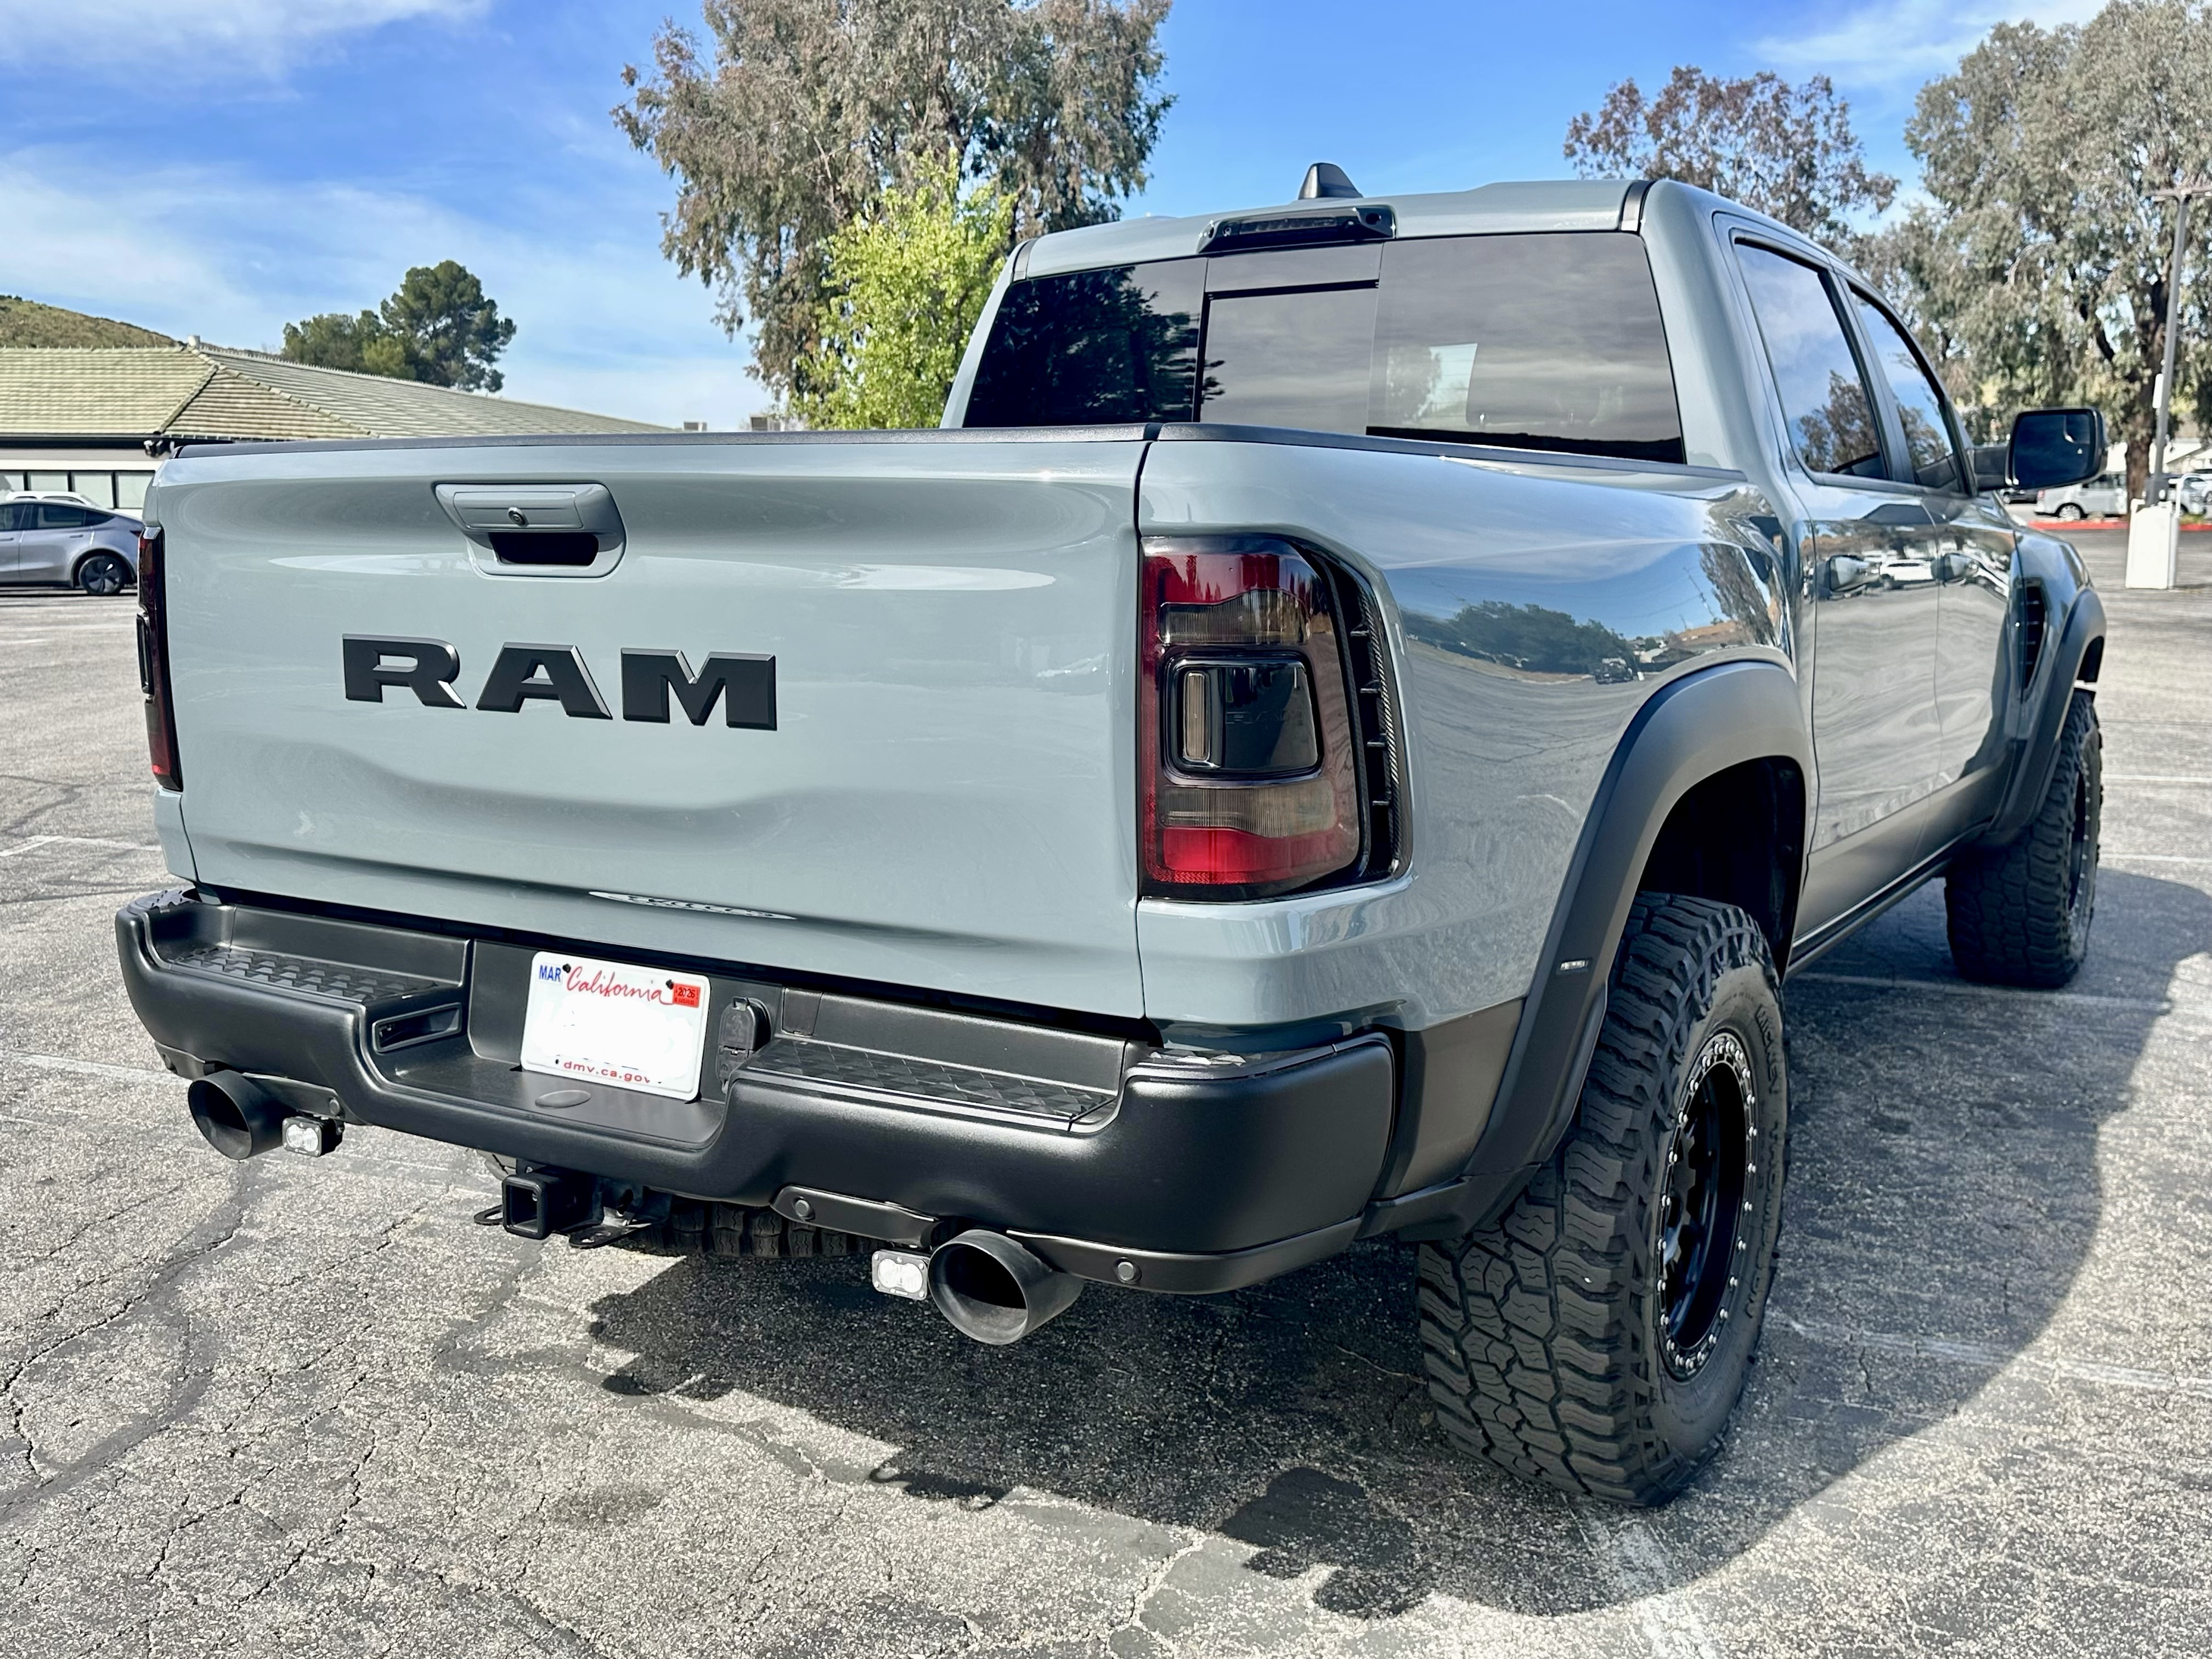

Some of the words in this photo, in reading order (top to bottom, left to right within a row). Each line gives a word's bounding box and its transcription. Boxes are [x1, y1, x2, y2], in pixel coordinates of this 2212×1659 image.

[342, 634, 777, 731] RAM
[539, 964, 562, 983] MAR
[567, 966, 674, 1005] California
[564, 1061, 650, 1084] dmv.ca.gov
[1755, 1003, 1779, 1094] MICKEY
[1745, 1121, 1780, 1318] THOMPSON
